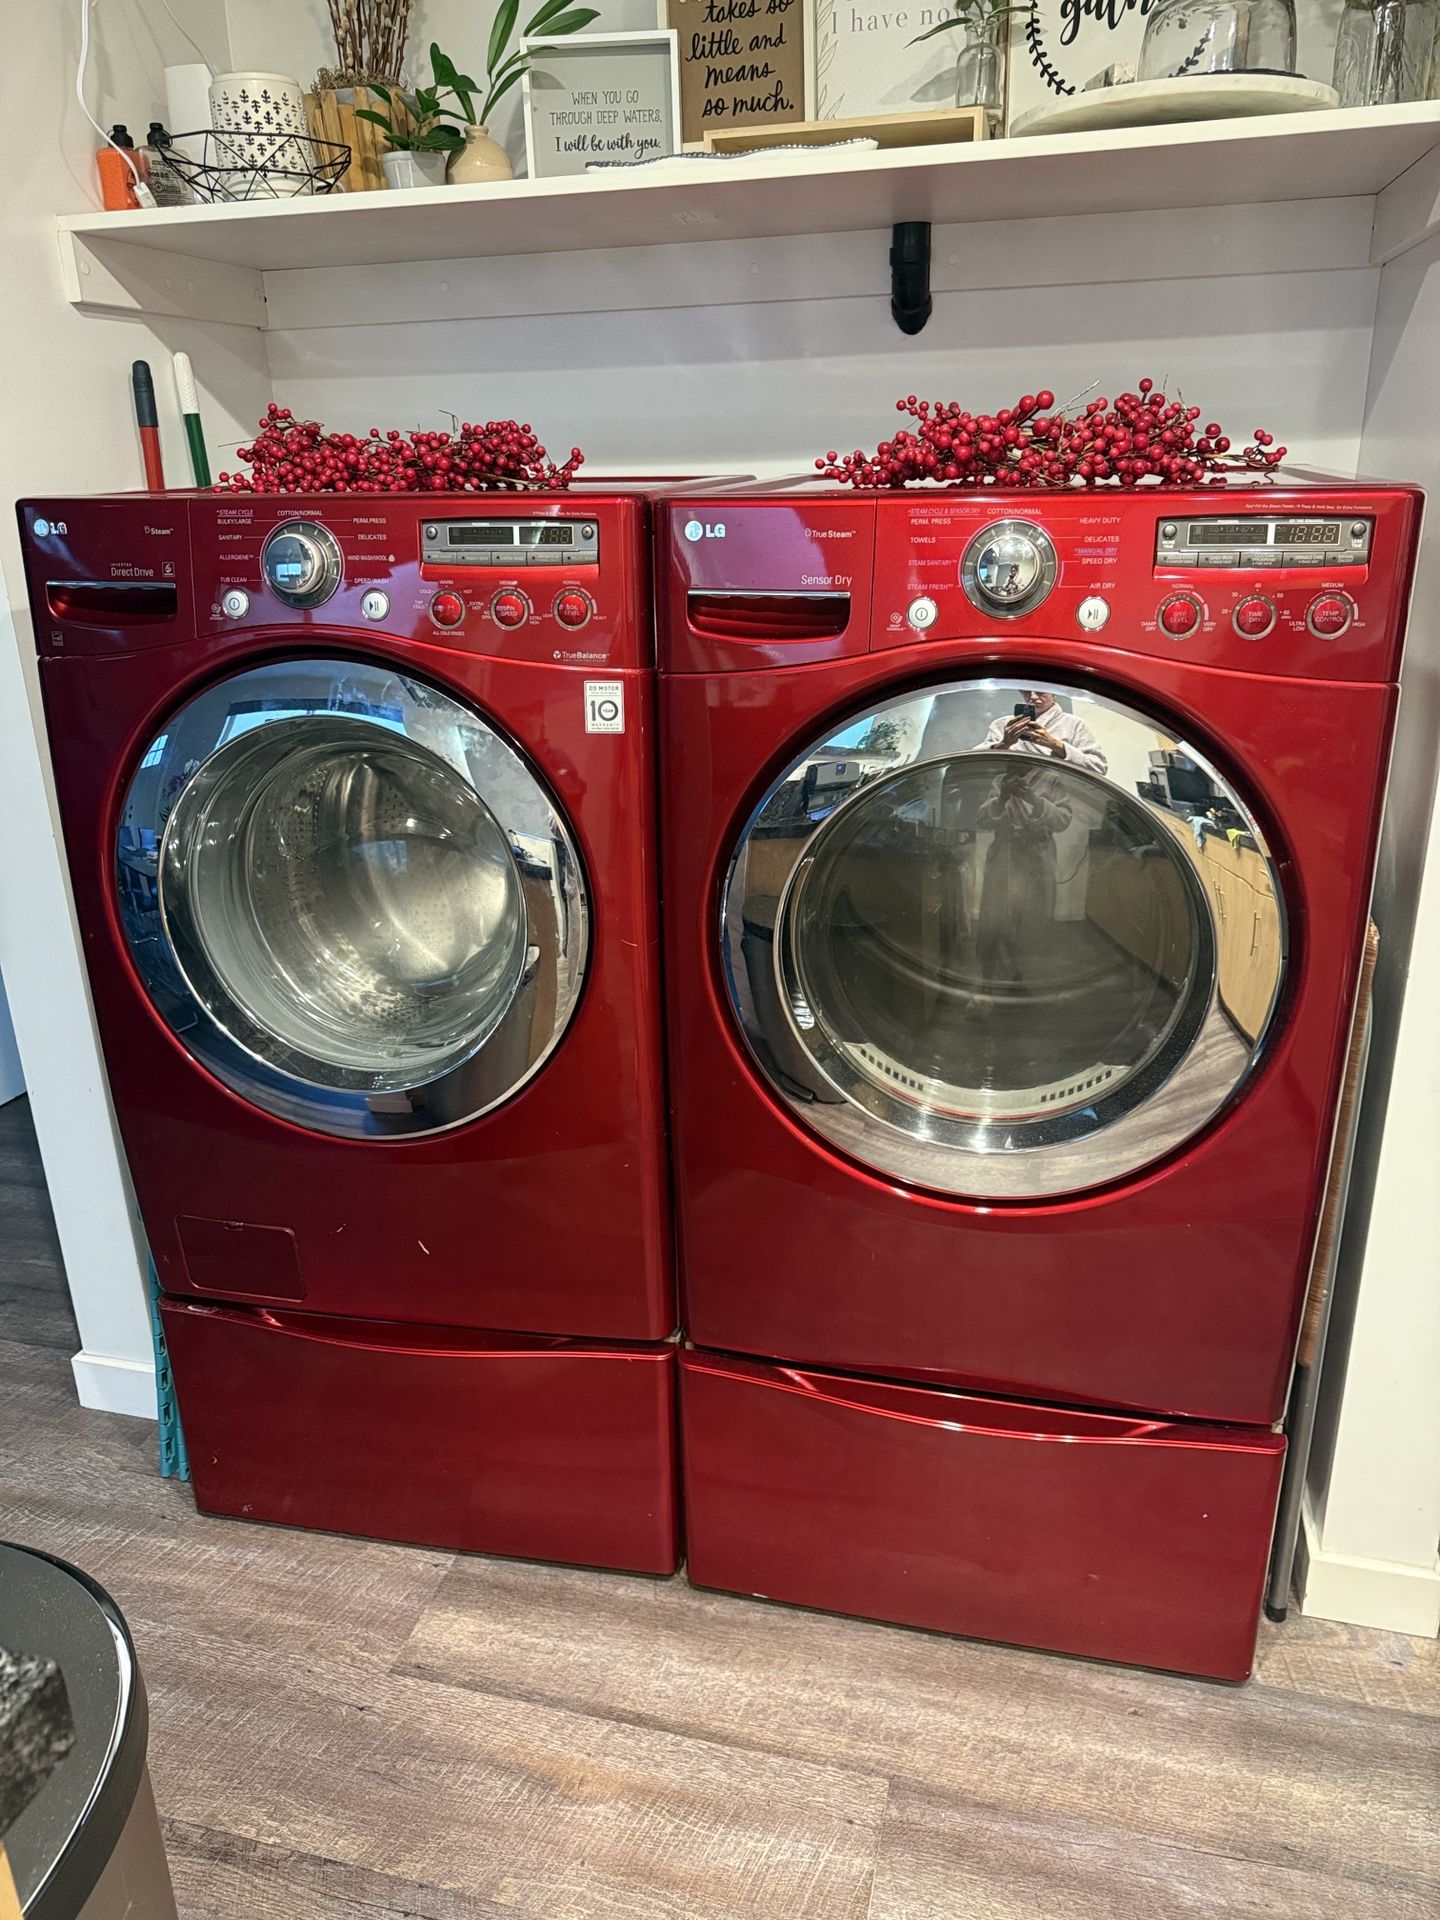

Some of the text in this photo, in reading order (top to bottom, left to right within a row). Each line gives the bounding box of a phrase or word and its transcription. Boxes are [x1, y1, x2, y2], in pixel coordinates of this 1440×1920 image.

[702, 0, 761, 22] takes
[832, 11, 838, 34] I
[851, 7, 908, 32] have
[685, 22, 787, 62] little and
[704, 62, 776, 89] means
[571, 89, 639, 105] WHEN YOU GO
[702, 80, 794, 118] so much.
[549, 111, 593, 126] THROUGH
[596, 110, 619, 124] DEEP
[555, 132, 661, 160] I will be with you.
[50, 521, 68, 535] LG
[705, 523, 726, 538] LG
[910, 536, 936, 544] TOWELS
[1084, 535, 1120, 543] DELICATES
[1081, 557, 1103, 565] SPEED
[111, 567, 133, 577] Direct
[134, 567, 154, 577] Drive
[801, 574, 853, 588] Sensor Dry
[1088, 582, 1101, 590] AIR
[590, 699, 619, 722] 10
